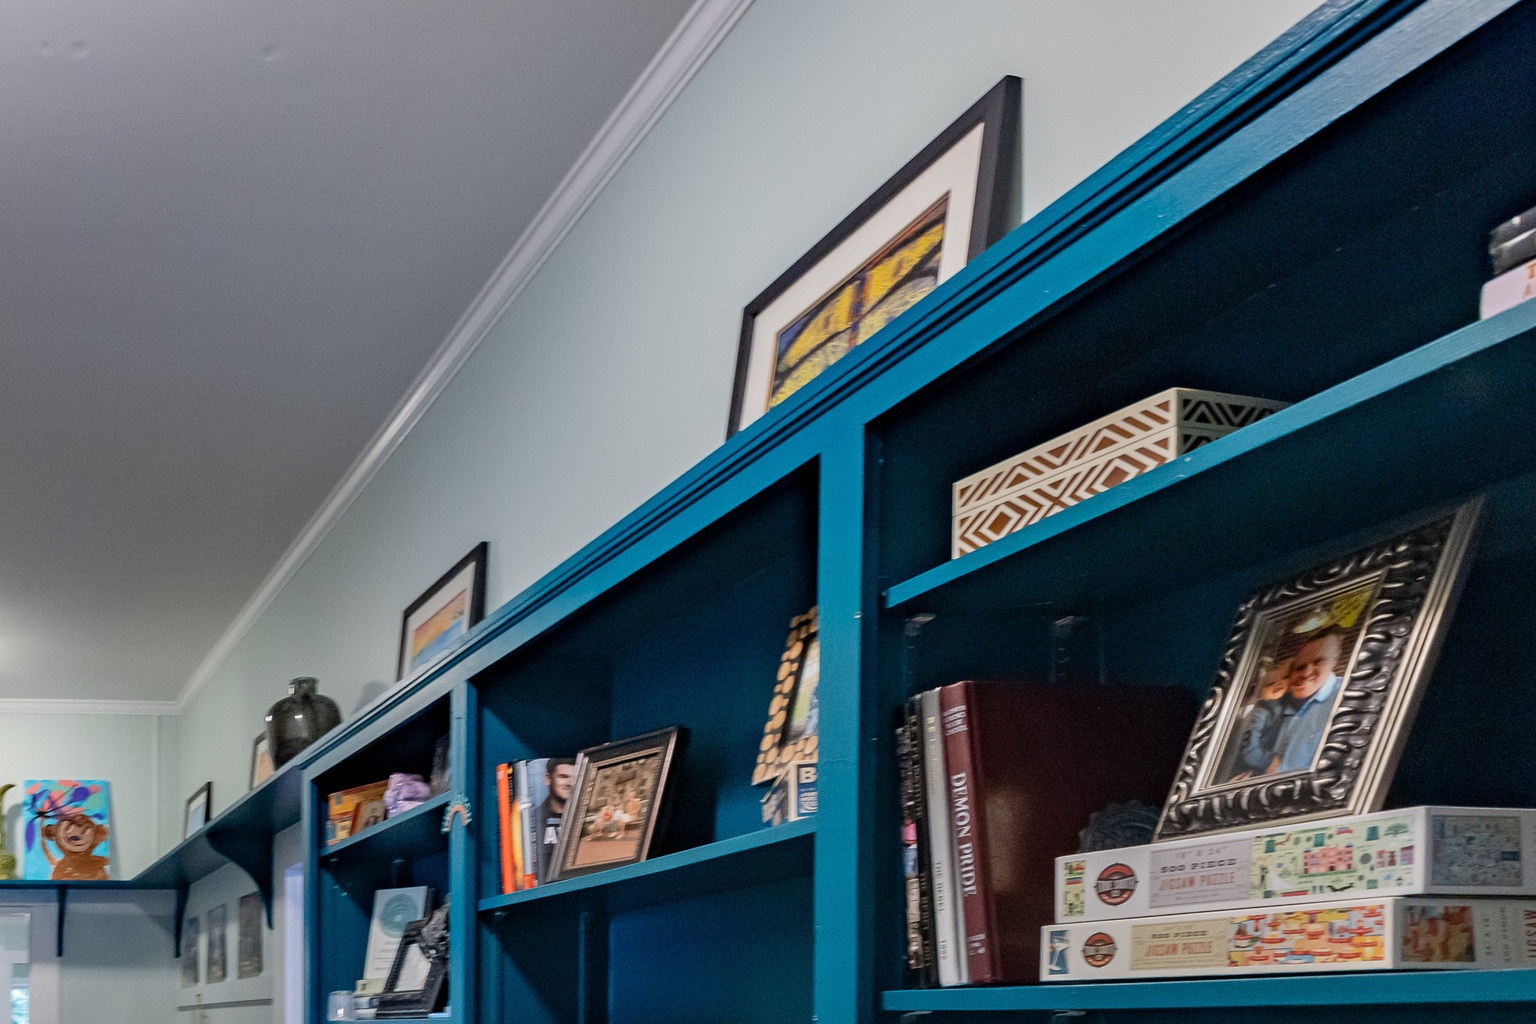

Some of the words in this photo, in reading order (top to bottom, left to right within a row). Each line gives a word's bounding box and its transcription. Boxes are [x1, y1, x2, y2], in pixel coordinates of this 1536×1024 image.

[951, 772, 972, 838] DEMON
[959, 842, 977, 897] PRIDE
[1160, 863, 1185, 874] 500
[1191, 858, 1236, 871] PIECE
[1159, 876, 1196, 891] JIGSAW
[1200, 871, 1235, 886] PUZZLE
[1151, 932, 1172, 940] 500
[1174, 930, 1208, 939] PIECE
[1145, 943, 1178, 957] JIGSAW
[1182, 941, 1213, 955] PUZZLE
